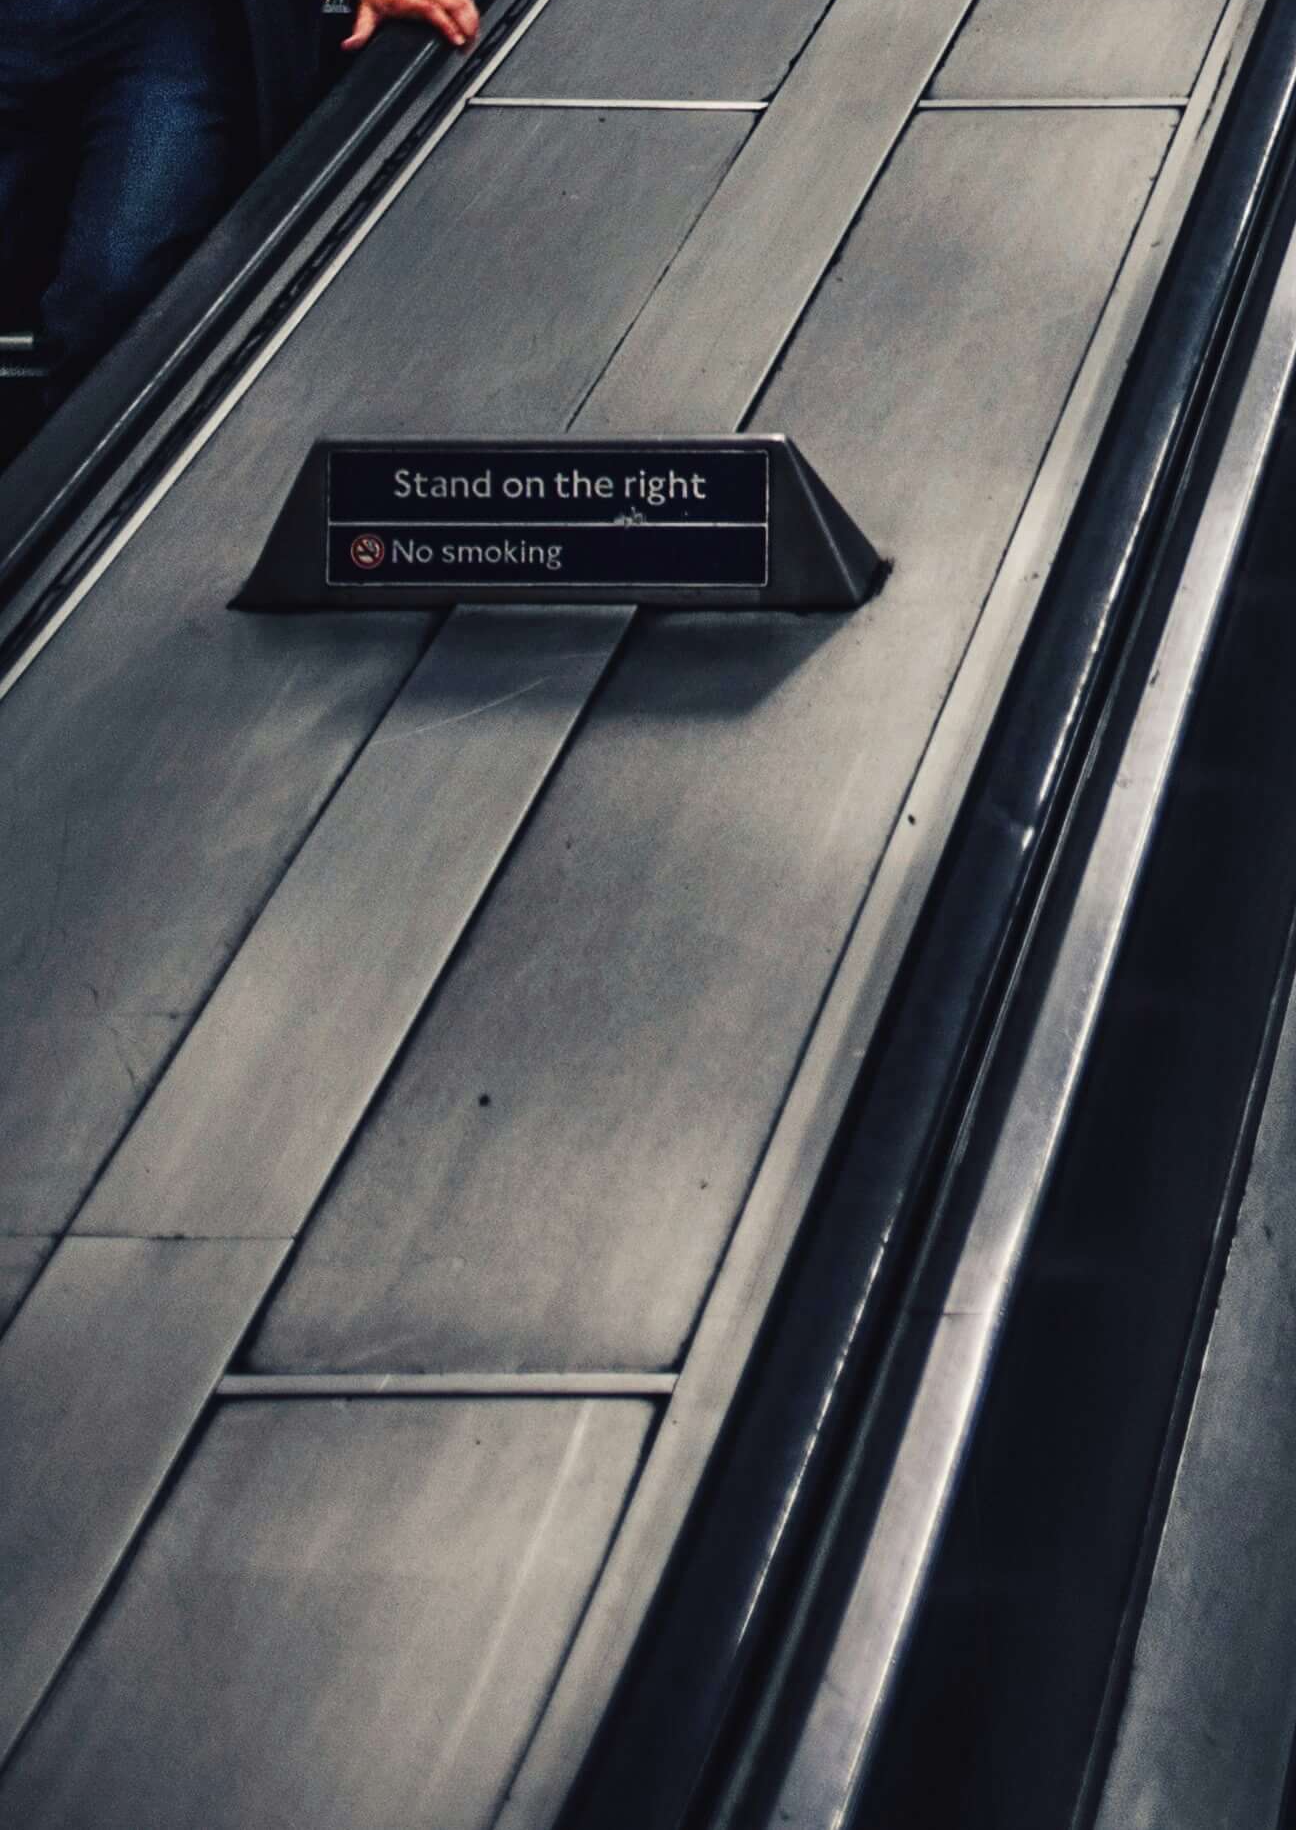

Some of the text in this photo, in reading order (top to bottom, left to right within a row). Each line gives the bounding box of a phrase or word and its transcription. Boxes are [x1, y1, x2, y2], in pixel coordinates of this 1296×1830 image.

[393, 469, 707, 508] Stand on the right
[391, 538, 563, 571] No smoking
